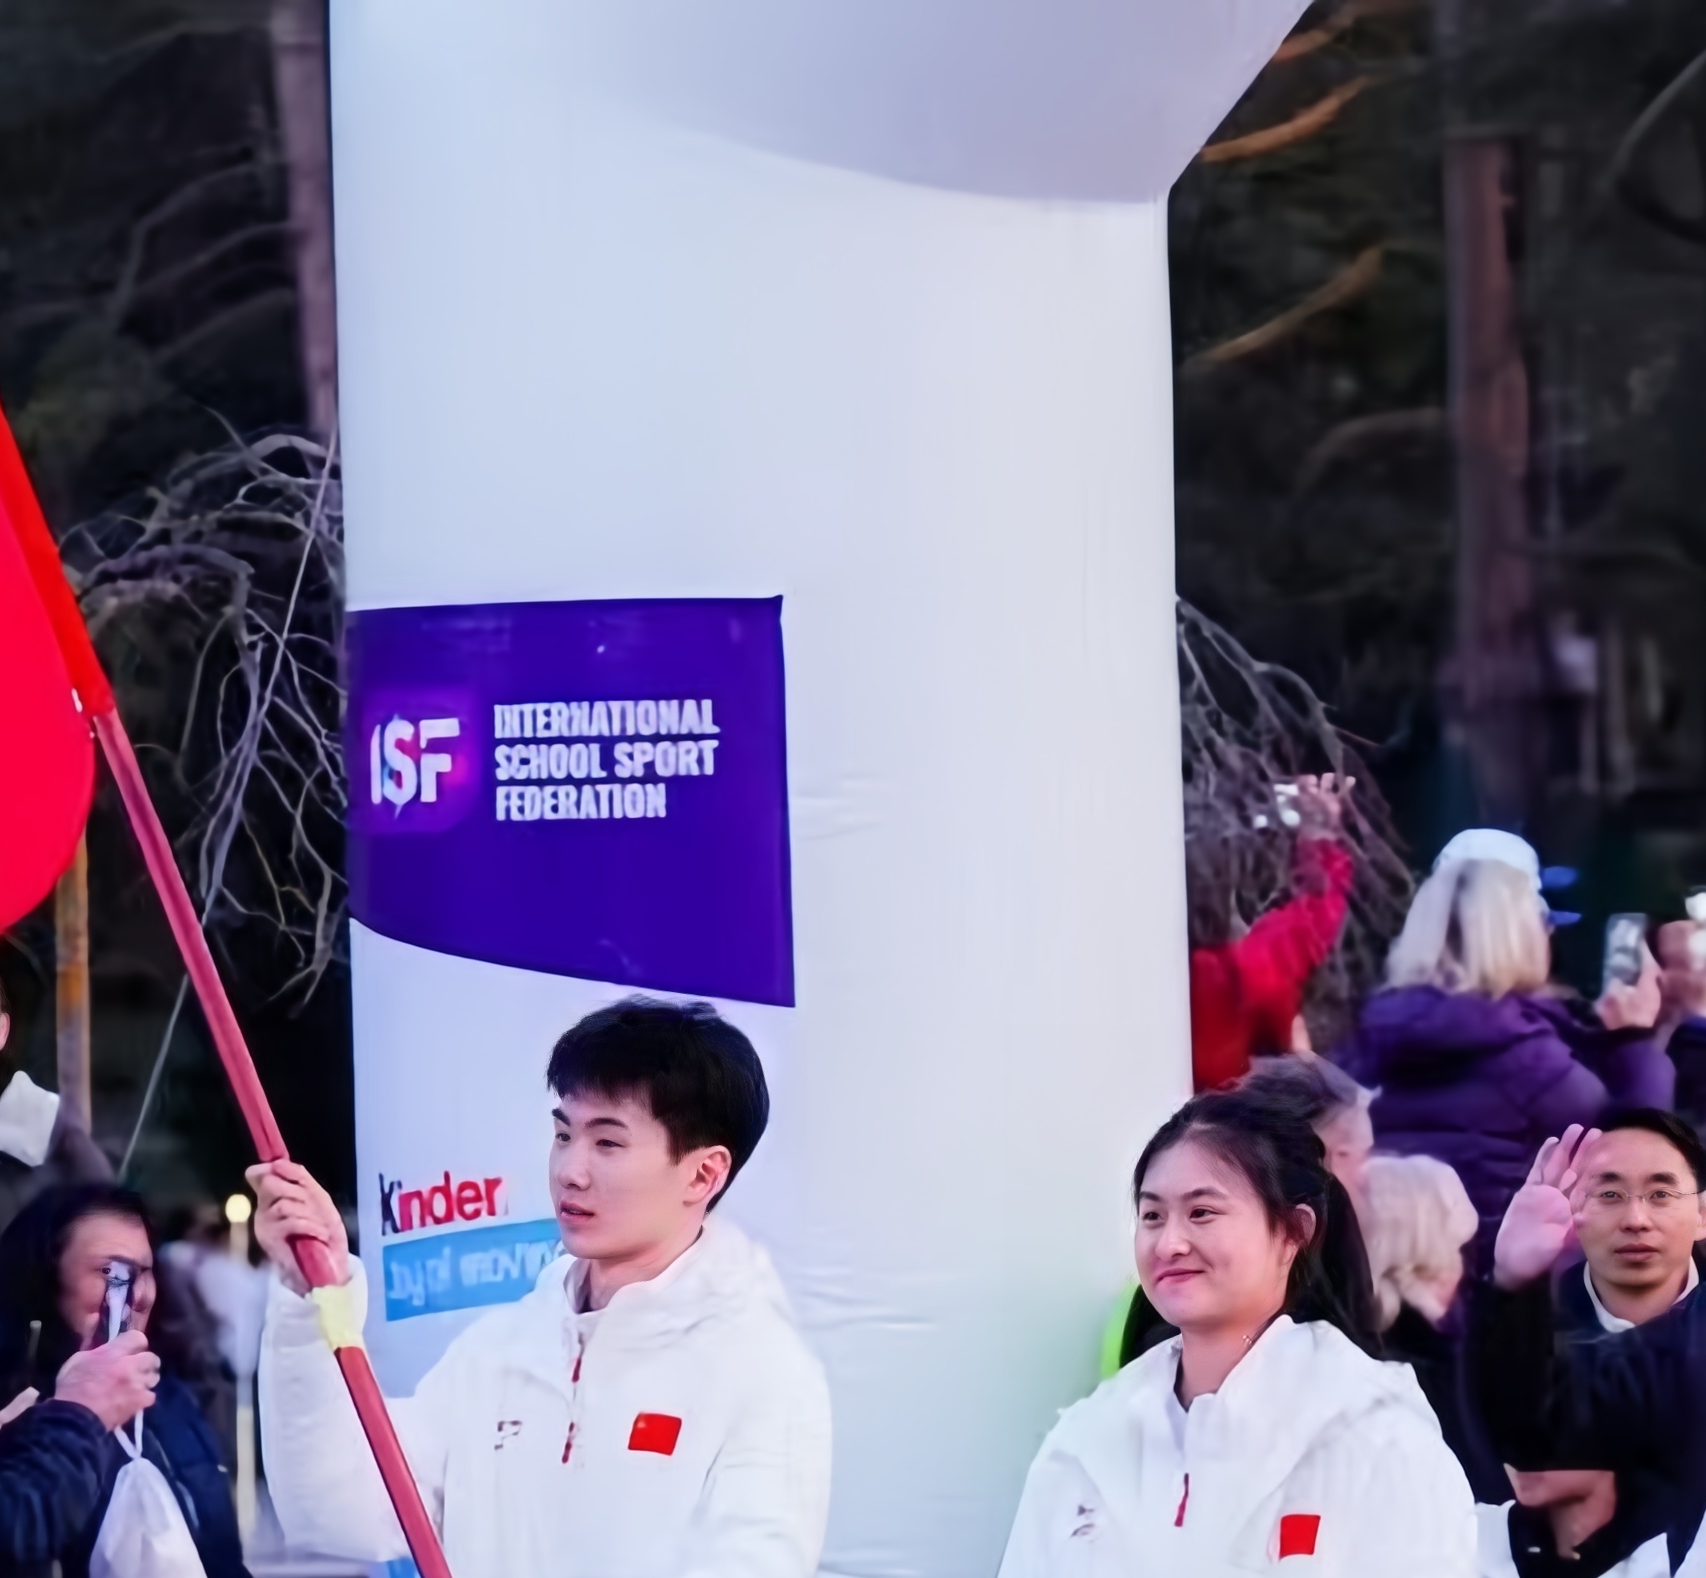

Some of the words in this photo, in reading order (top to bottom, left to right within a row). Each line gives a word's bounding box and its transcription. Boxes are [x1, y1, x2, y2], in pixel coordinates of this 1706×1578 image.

[494, 699, 721, 738] INTERNATIONAL
[370, 715, 461, 813] ISF
[494, 743, 608, 780] SCHOOL
[613, 740, 720, 778] SPORT
[496, 783, 667, 821] FEDERATION
